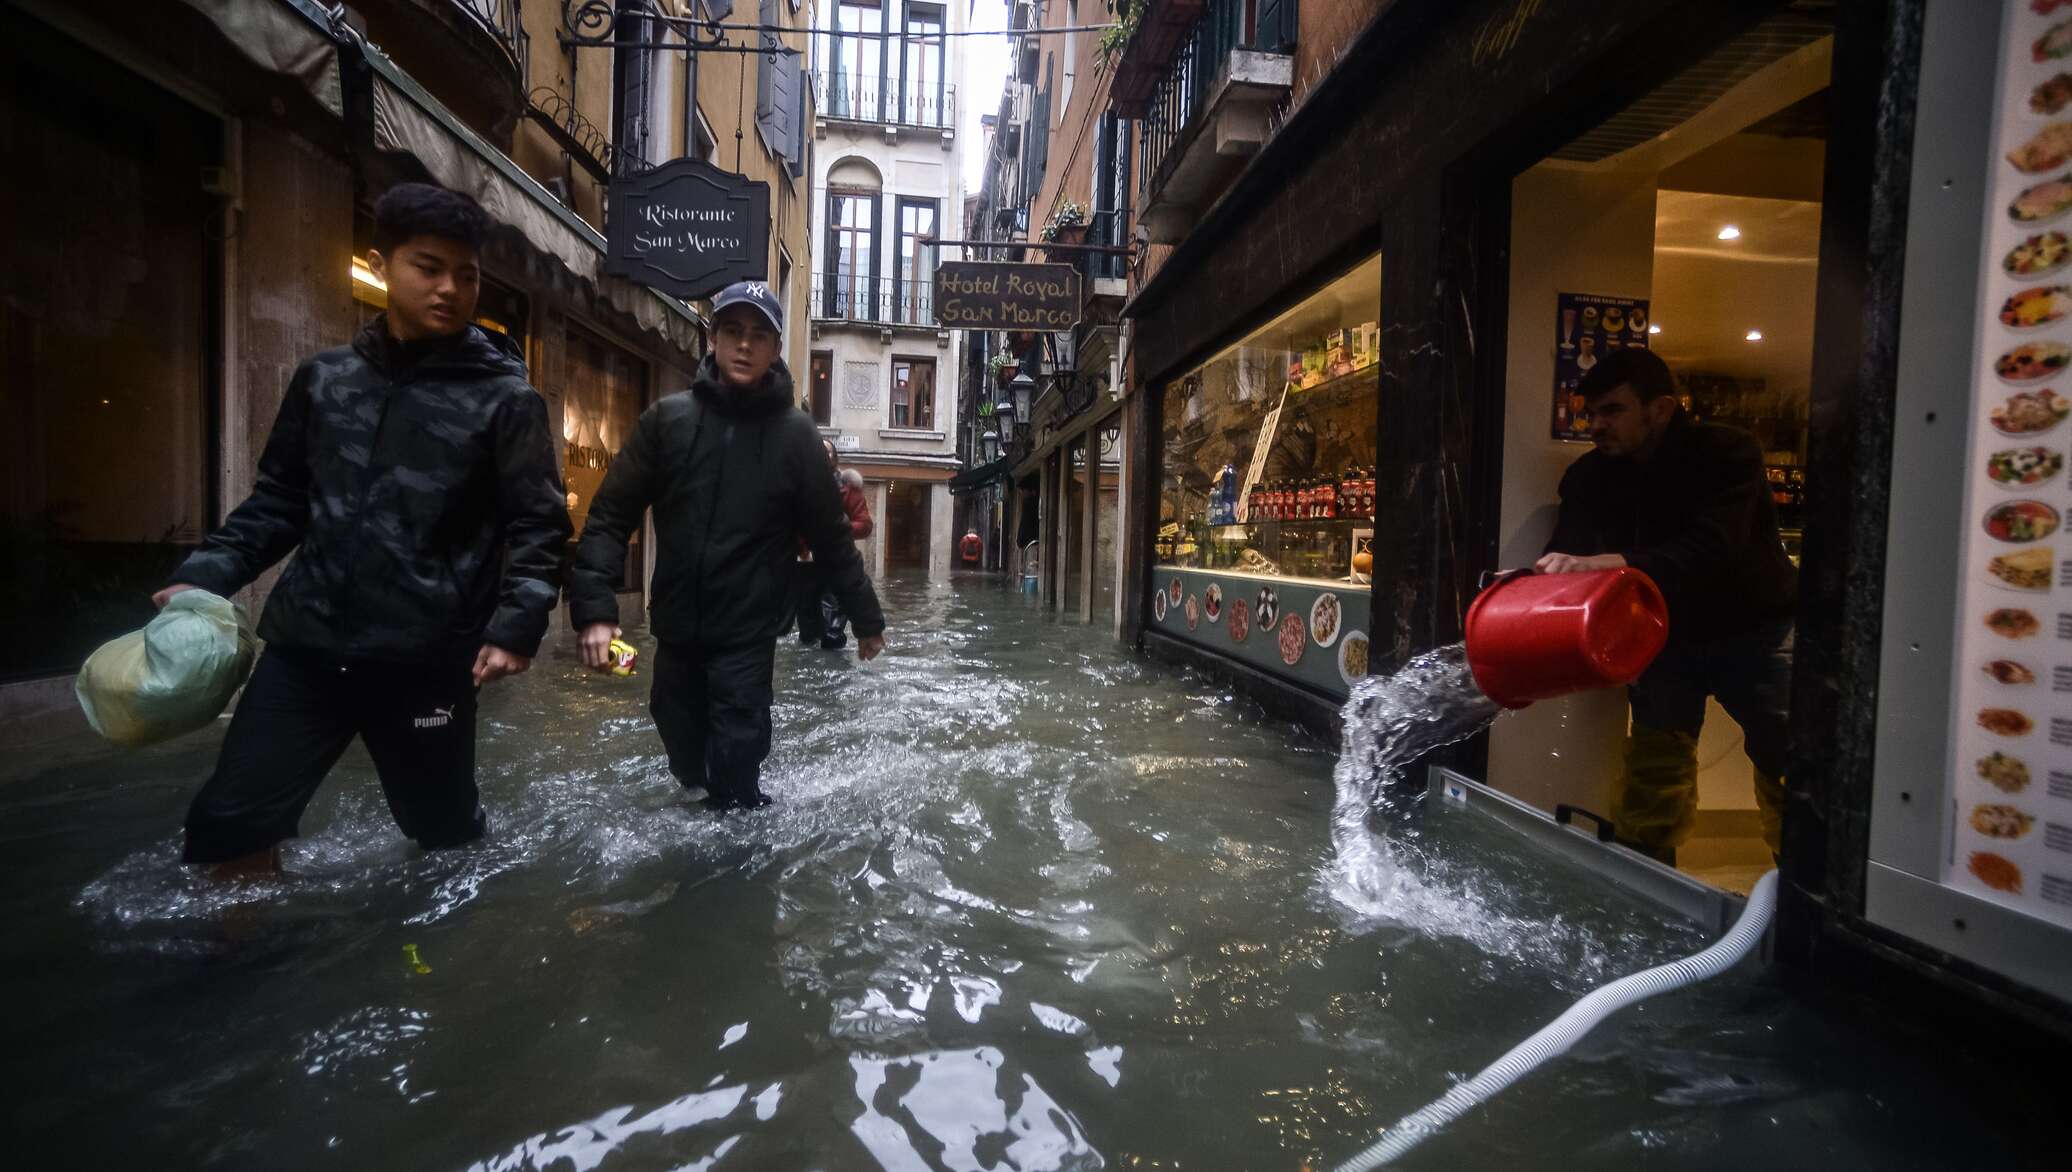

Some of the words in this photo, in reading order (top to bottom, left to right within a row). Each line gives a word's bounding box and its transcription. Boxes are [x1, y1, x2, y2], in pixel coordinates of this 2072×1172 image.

[639, 204, 735, 227] Ristorante
[633, 230, 672, 252] San
[678, 231, 740, 253] Marco
[745, 282, 764, 299] NY
[938, 271, 999, 295] Hotel
[1006, 272, 1073, 301] Royal
[1001, 301, 1072, 324] Marco
